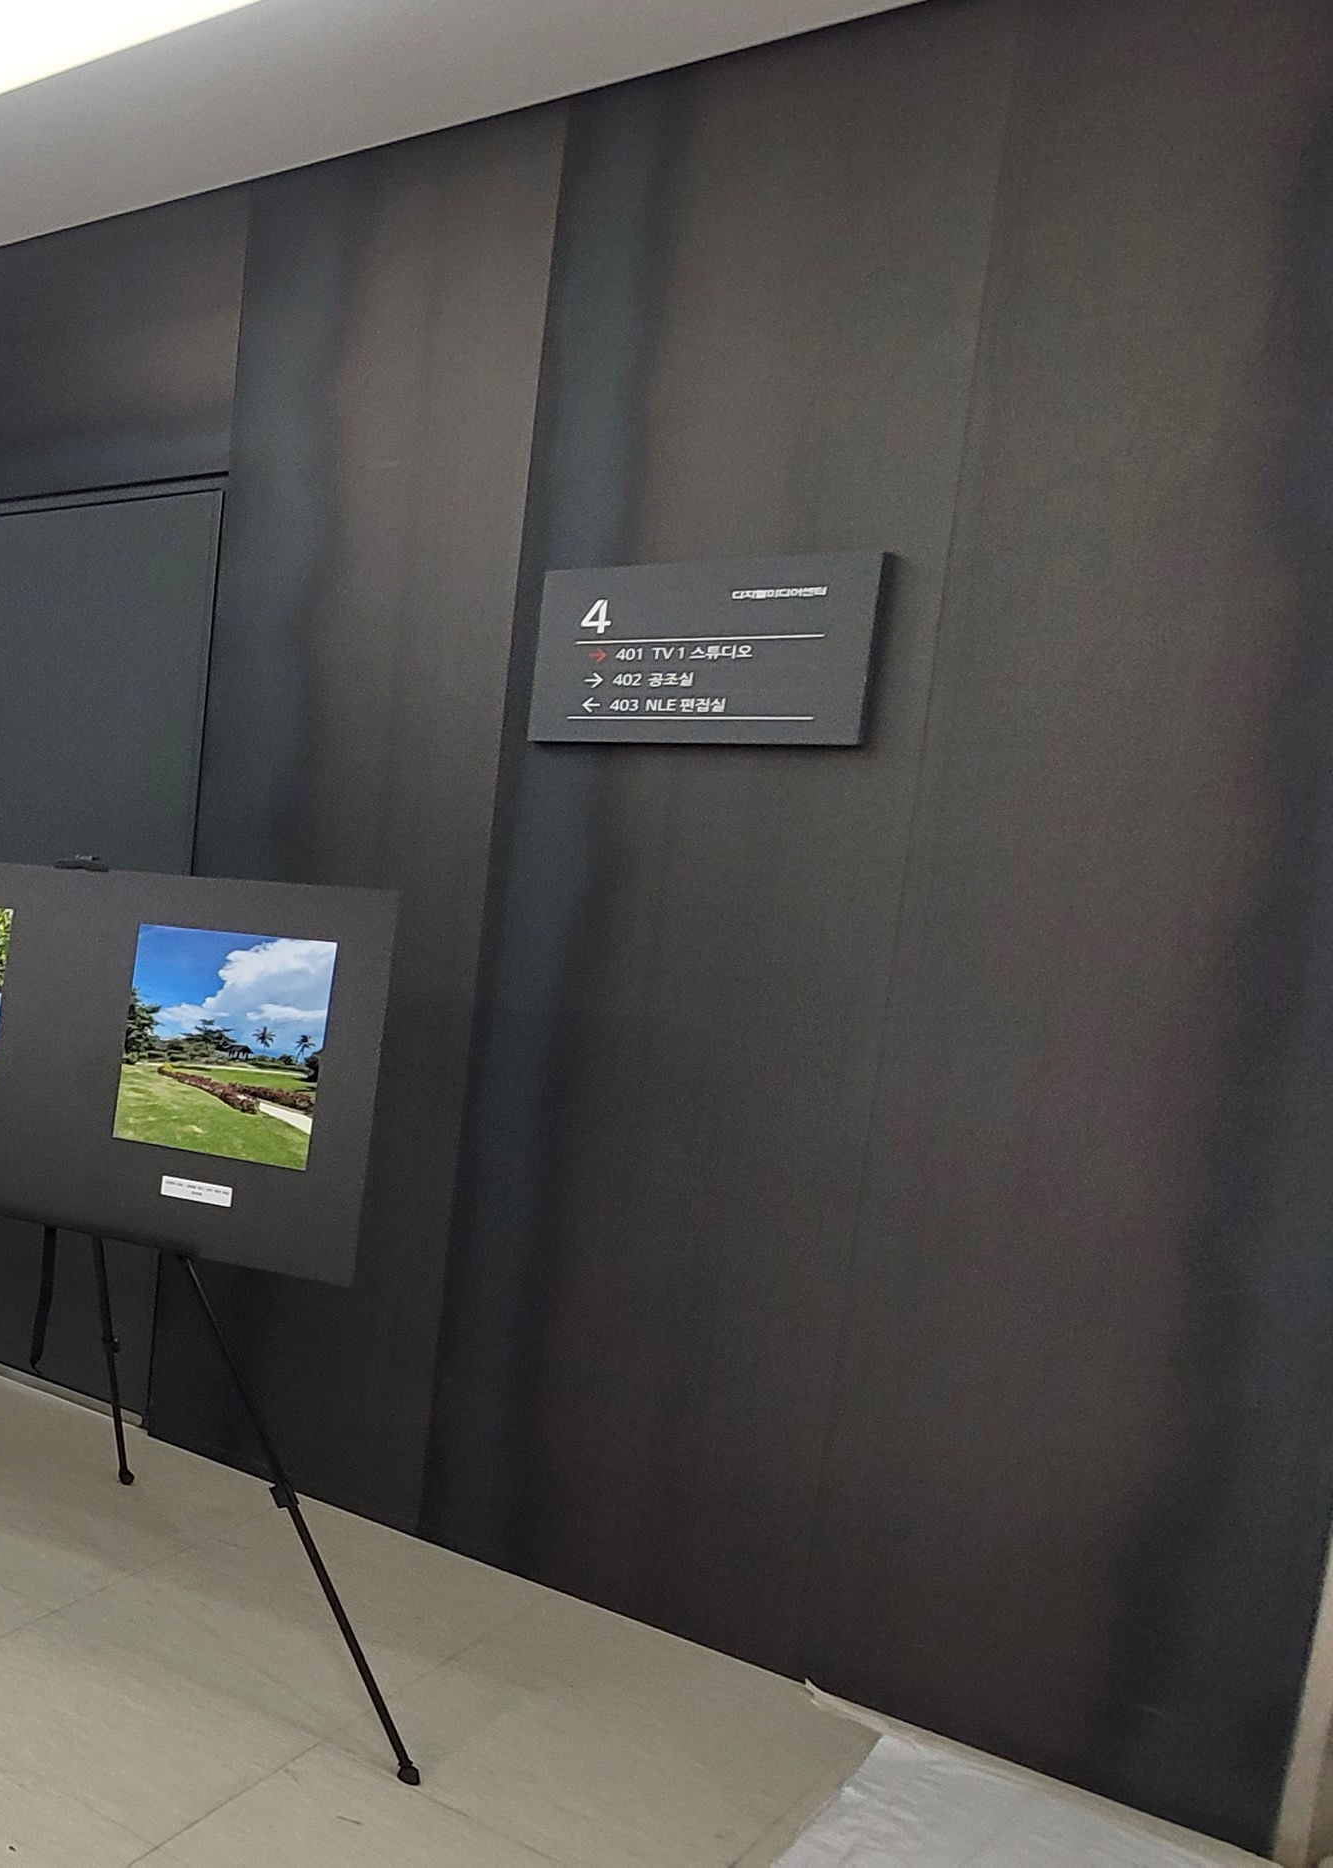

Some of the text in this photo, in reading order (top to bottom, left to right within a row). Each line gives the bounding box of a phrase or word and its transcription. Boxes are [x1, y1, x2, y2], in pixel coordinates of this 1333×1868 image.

[580, 598, 612, 634] 4
[615, 647, 643, 661] 401
[652, 647, 674, 660] TV
[689, 644, 754, 660] 스튜디오
[612, 672, 695, 687] 402 공조실
[609, 697, 726, 713] 403 NLE 편집실
